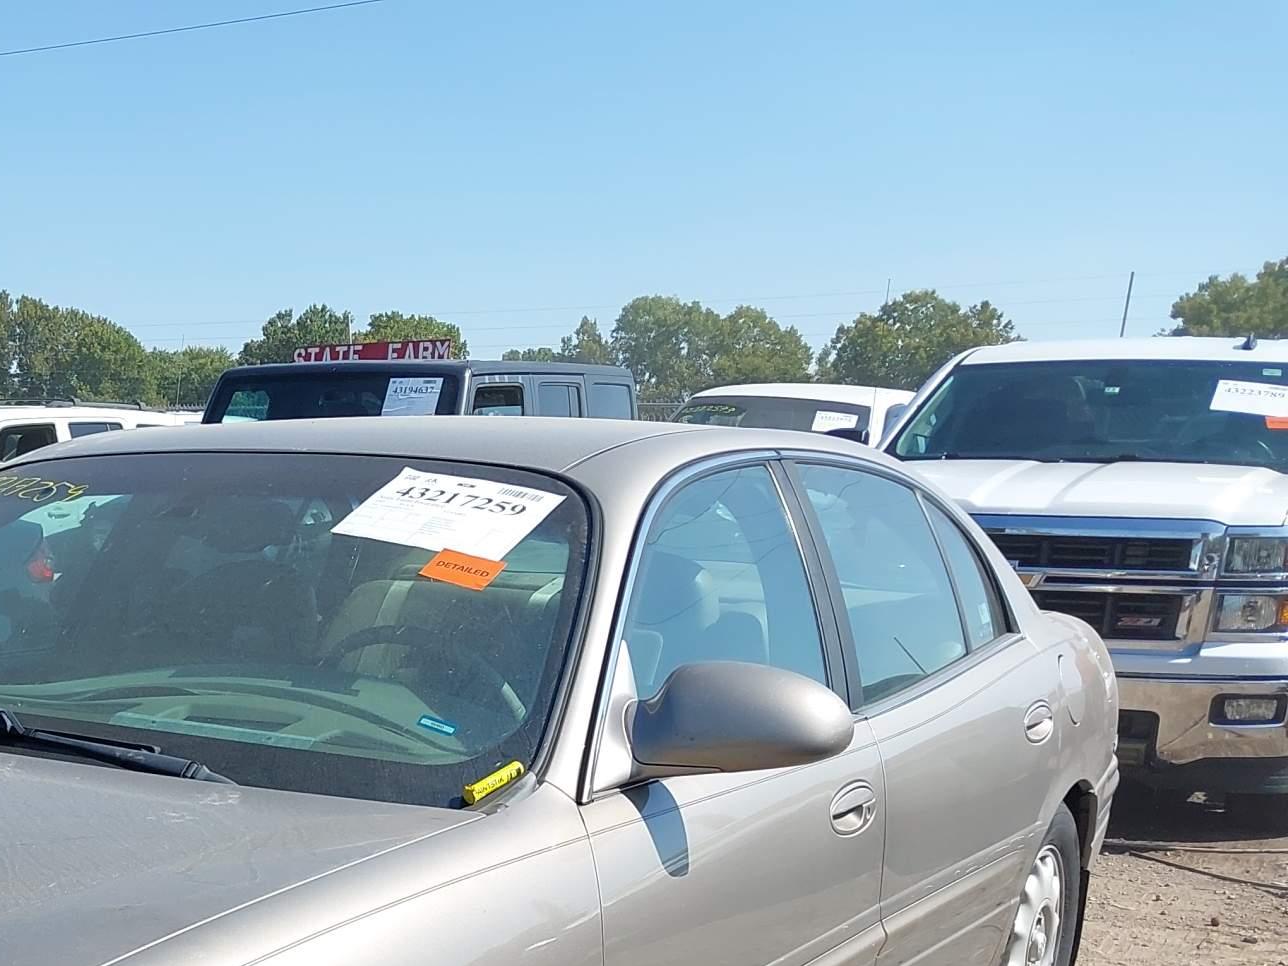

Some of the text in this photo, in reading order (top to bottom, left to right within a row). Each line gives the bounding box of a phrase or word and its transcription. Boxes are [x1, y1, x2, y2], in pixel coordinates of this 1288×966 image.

[293, 340, 450, 363] STATE FARM
[396, 486, 527, 516] 43217259
[436, 560, 490, 578] DETAILED
